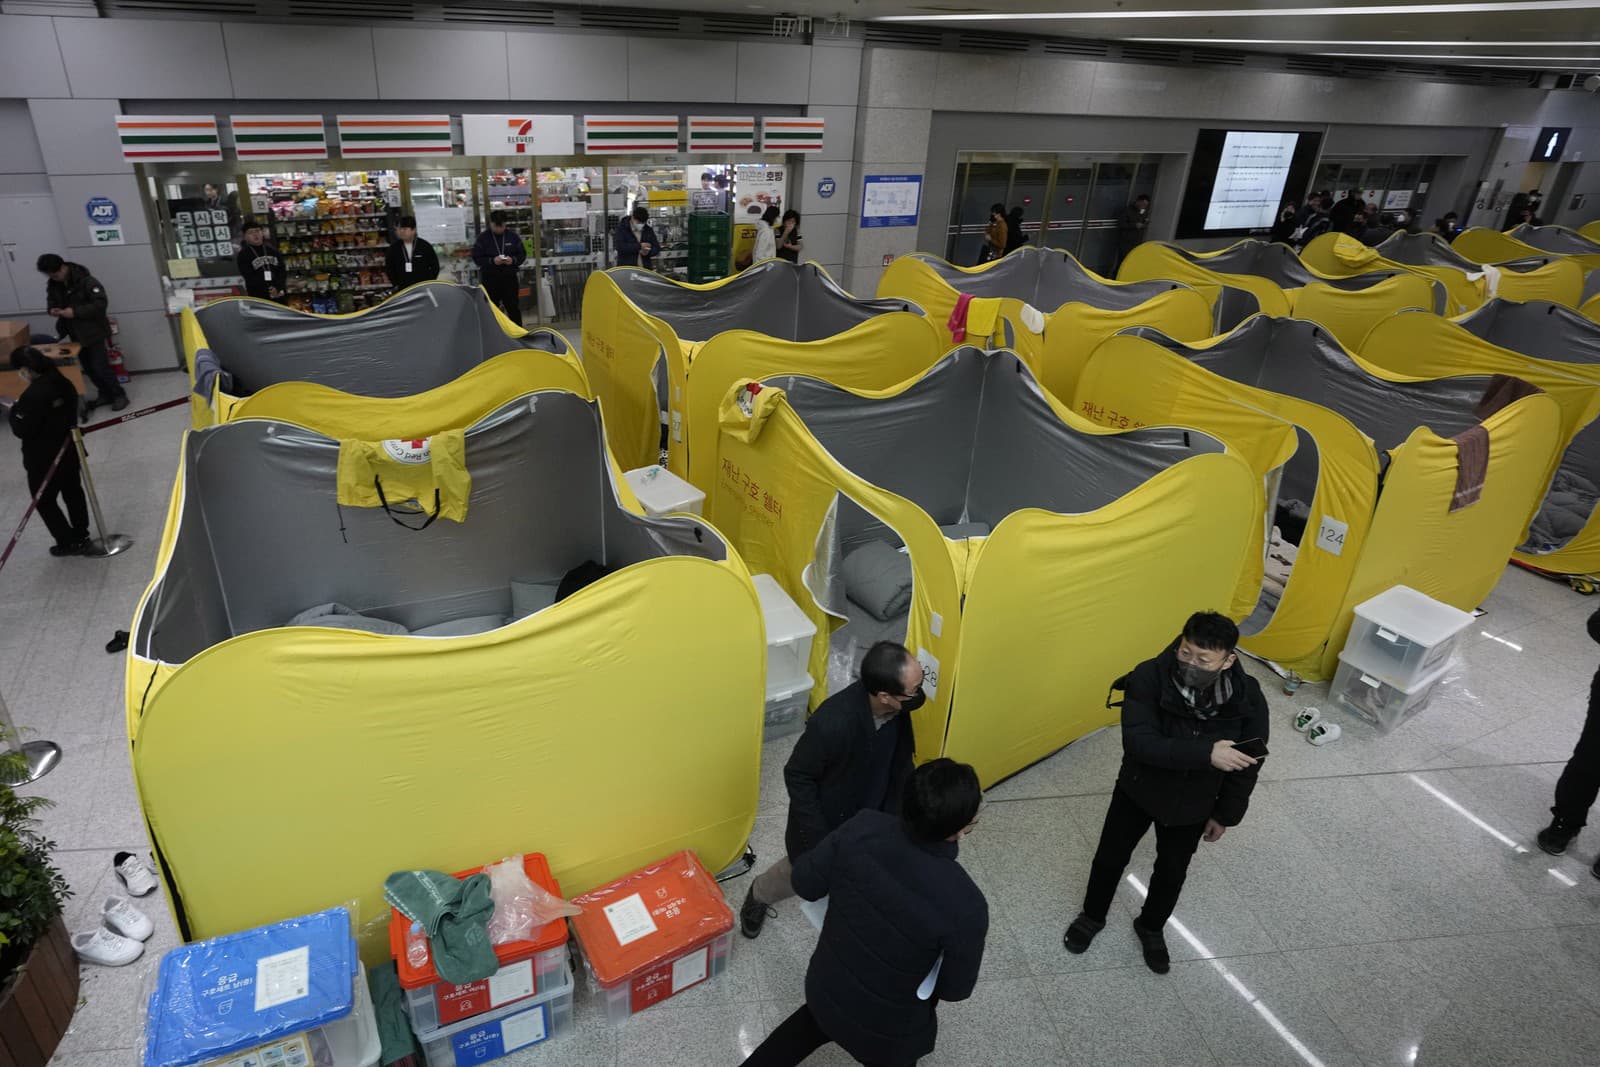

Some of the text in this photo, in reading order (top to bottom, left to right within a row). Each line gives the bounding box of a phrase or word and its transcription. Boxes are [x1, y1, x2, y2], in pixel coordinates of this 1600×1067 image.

[508, 119, 532, 152] 7
[766, 171, 783, 182] 호빵
[92, 205, 113, 217] ADT
[179, 211, 225, 224] 도시락
[1082, 401, 1104, 421] 재난
[1108, 409, 1129, 429] 구호
[721, 457, 741, 484] 재난
[742, 473, 760, 501] 구호
[763, 491, 783, 520] 쉘터
[1320, 526, 1344, 546] 124
[919, 662, 937, 688] 28
